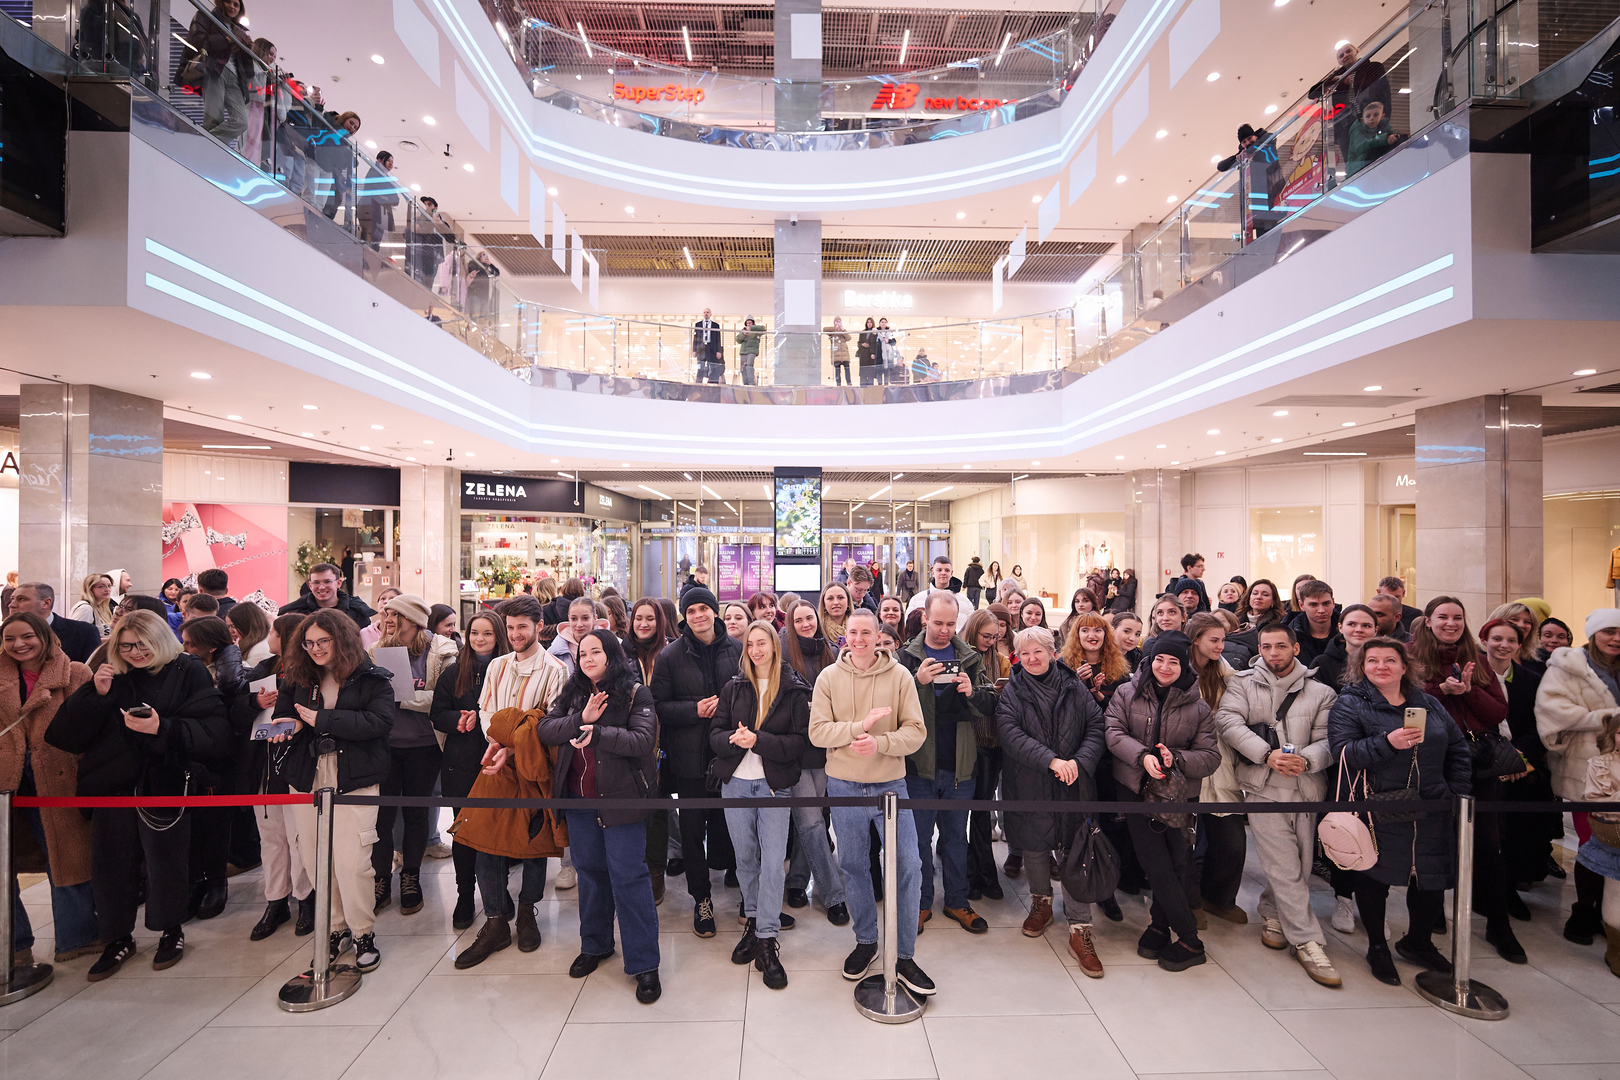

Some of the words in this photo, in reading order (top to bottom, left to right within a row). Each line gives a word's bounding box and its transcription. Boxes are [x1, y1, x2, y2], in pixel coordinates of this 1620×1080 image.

[613, 82, 705, 105] SuperStep
[870, 83, 920, 109] NB
[924, 96, 956, 109] new
[844, 289, 913, 309] Bershka
[465, 482, 527, 498] ZELENA
